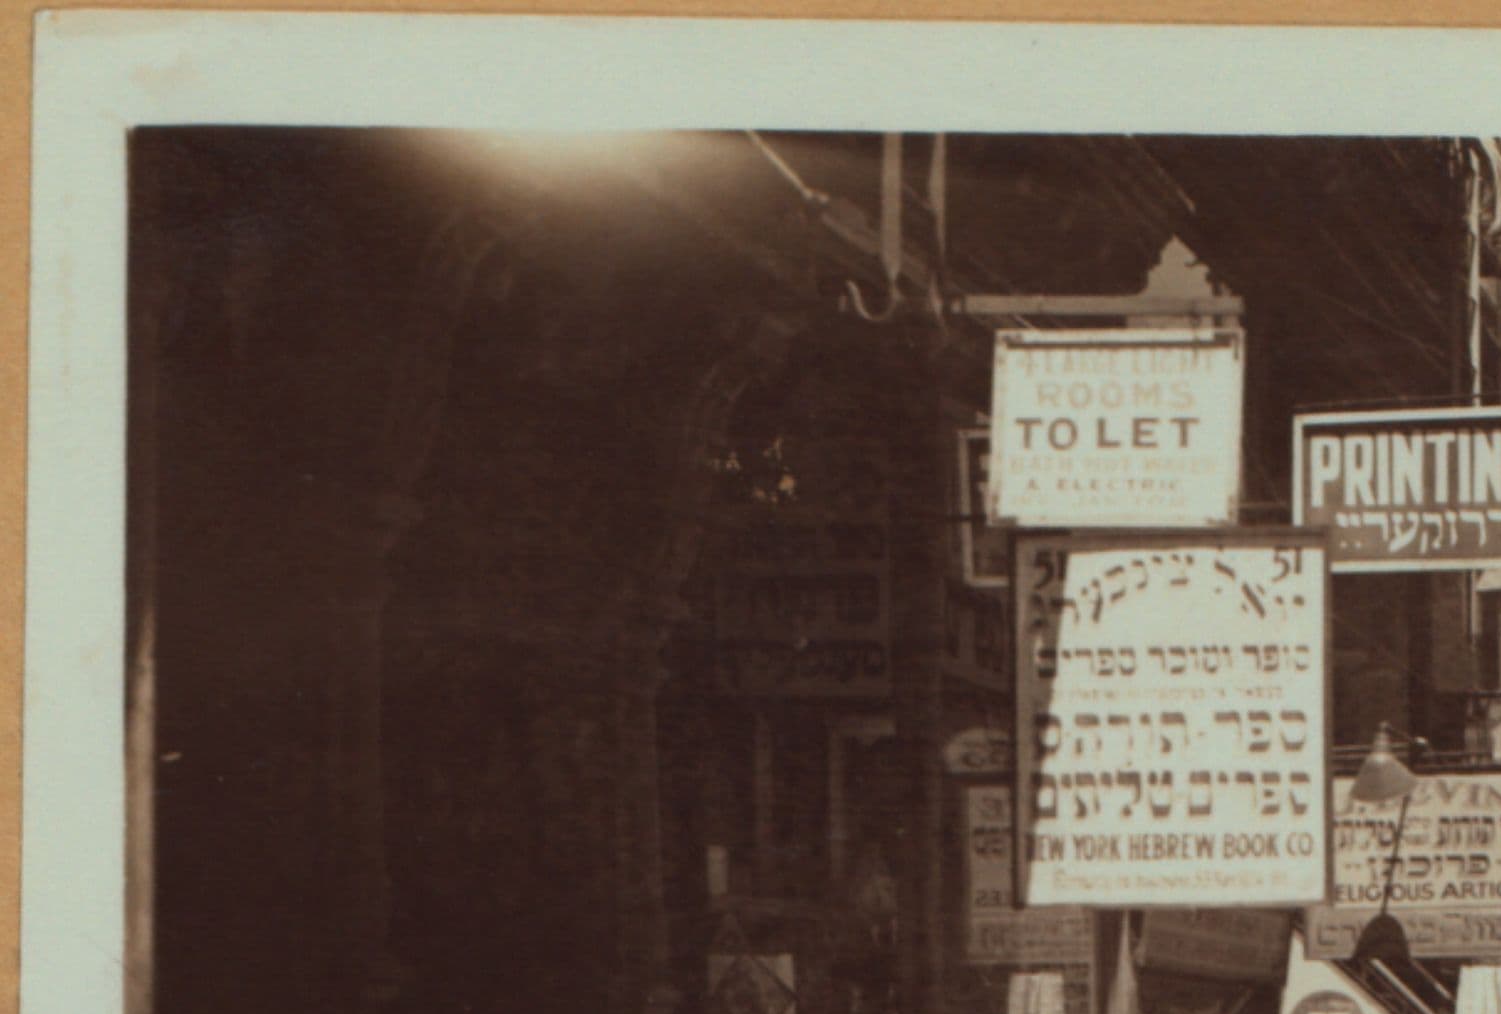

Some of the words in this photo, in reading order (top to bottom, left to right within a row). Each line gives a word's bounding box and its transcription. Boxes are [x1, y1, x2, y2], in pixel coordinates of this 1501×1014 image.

[1036, 381, 1195, 409] ROOMS
[1014, 416, 1079, 451] TO
[1095, 416, 1200, 449] LET
[1056, 478, 1181, 491] ELECTRIC
[1032, 550, 1067, 589] 51
[1270, 547, 1303, 582] 51
[1211, 709, 1307, 754] ספר
[1071, 834, 1120, 862] YORK
[1126, 833, 1214, 861] HEBREW
[1221, 832, 1279, 860] BOOK
[1282, 830, 1315, 858] CO
[1334, 882, 1435, 902] ELIGIOUS
